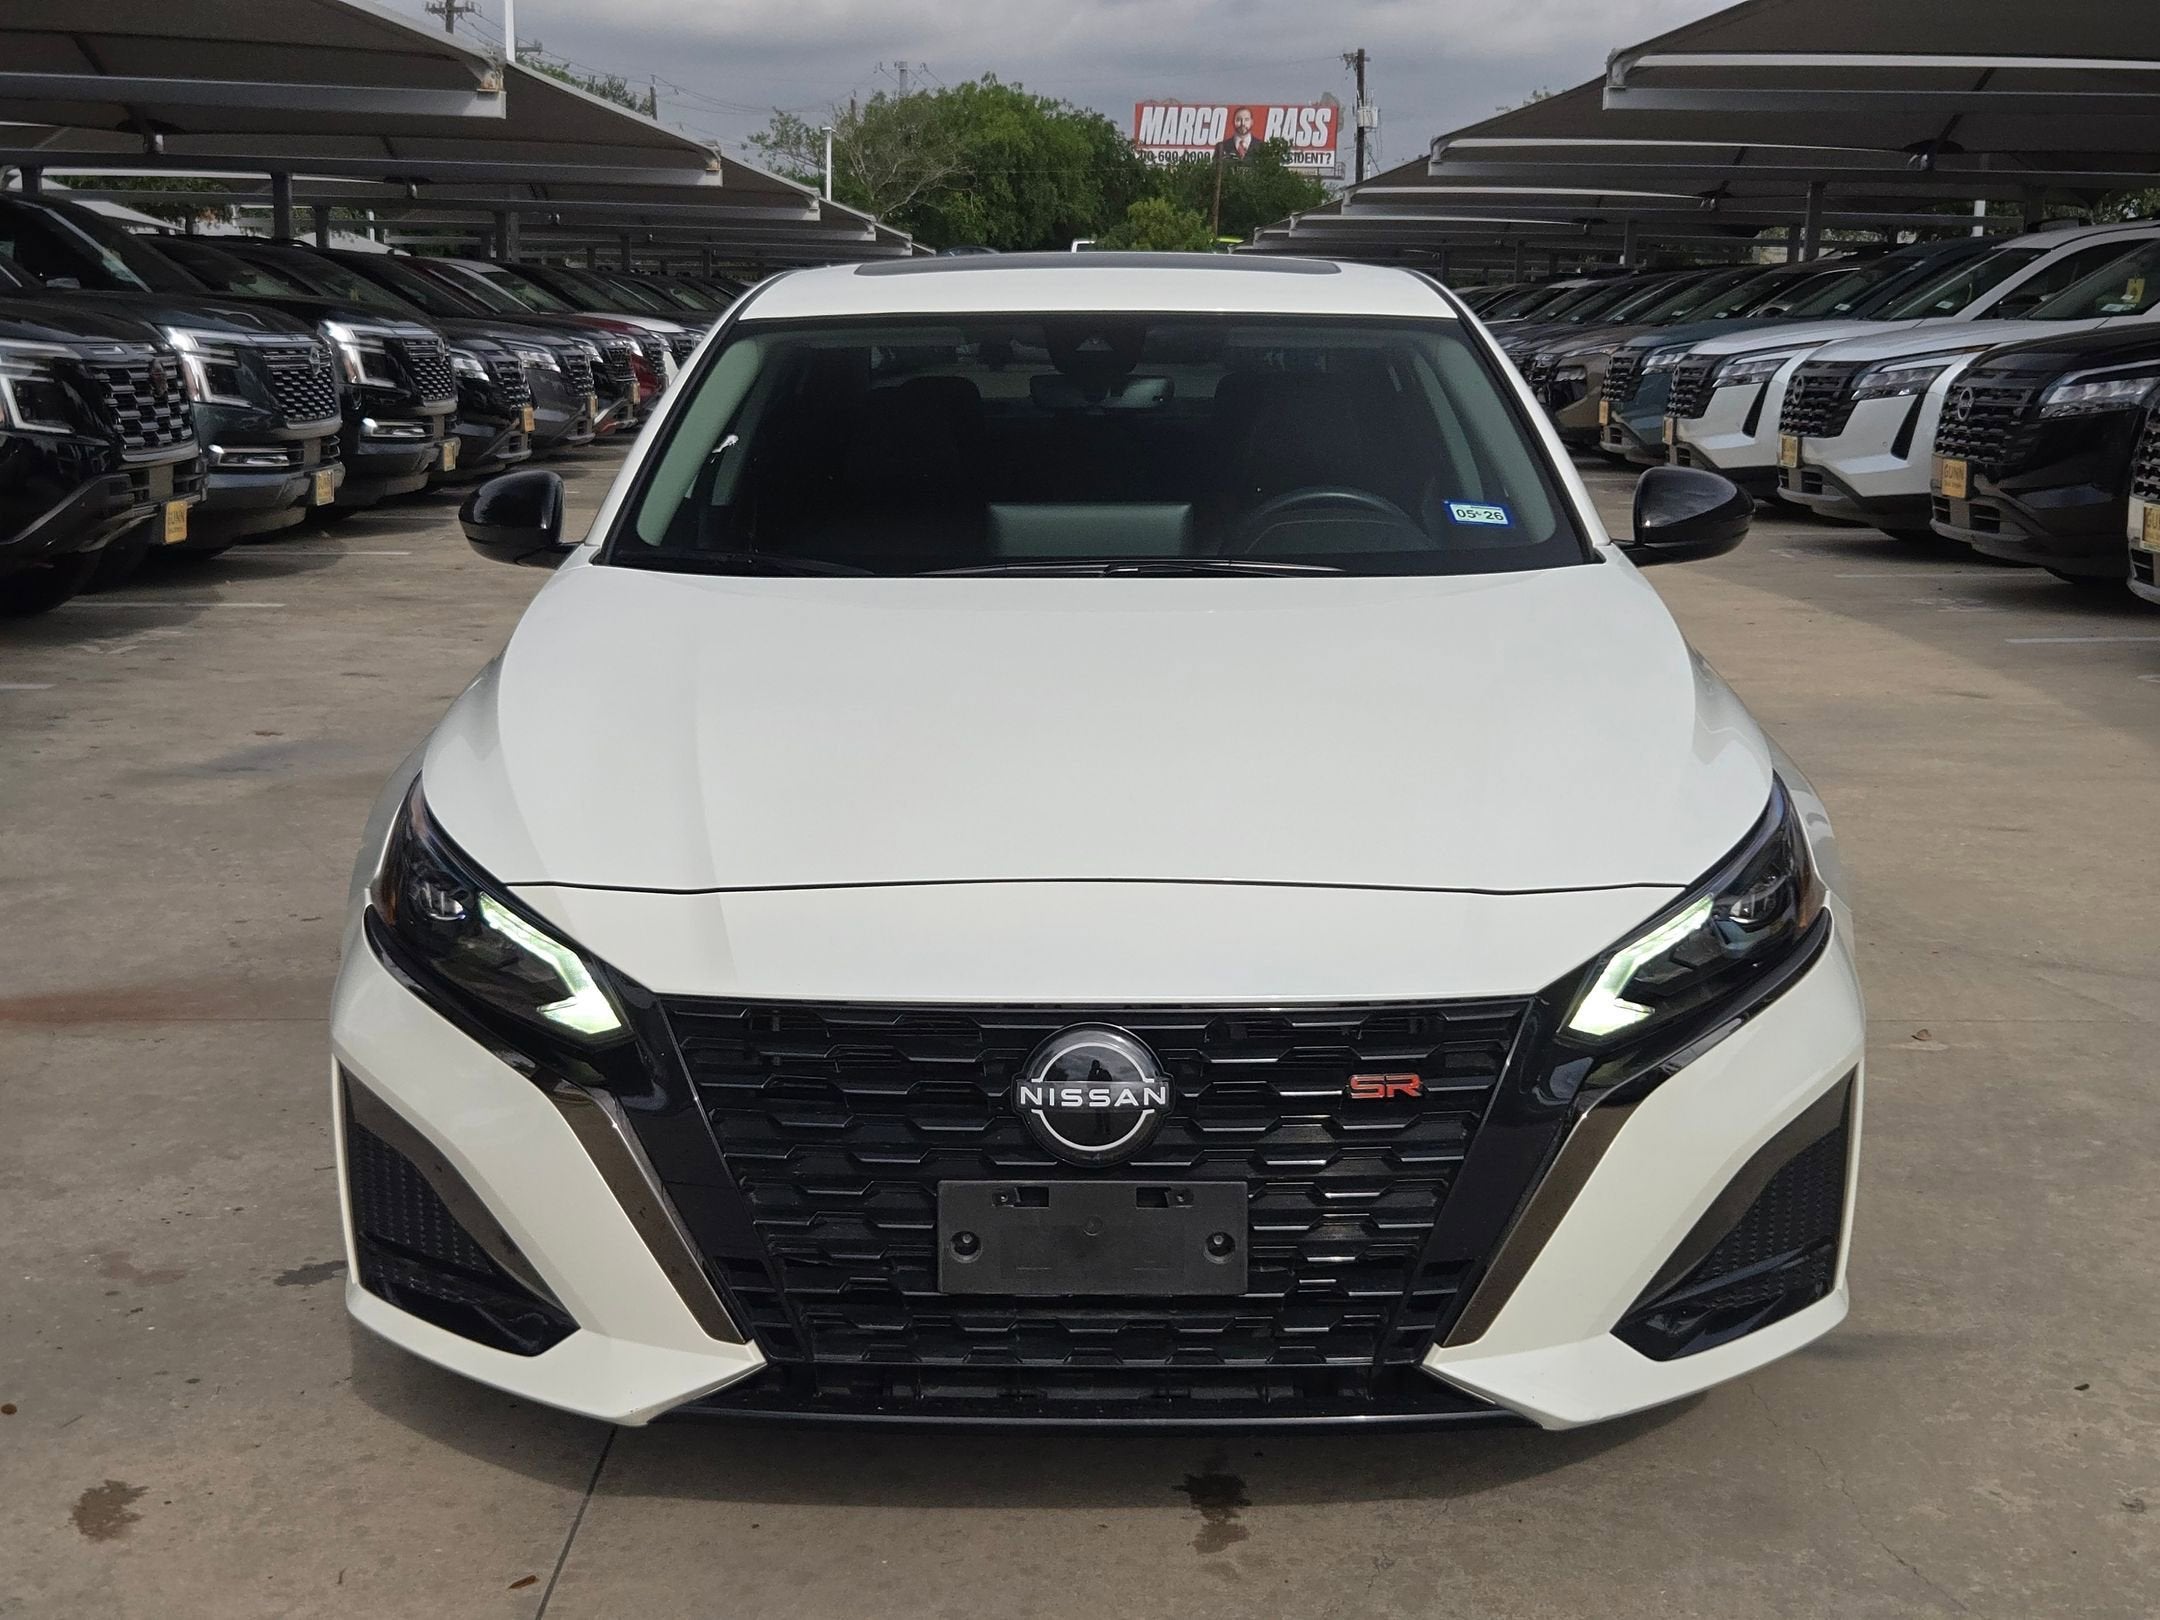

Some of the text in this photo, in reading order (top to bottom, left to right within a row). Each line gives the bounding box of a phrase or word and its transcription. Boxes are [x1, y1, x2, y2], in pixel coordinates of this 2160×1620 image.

[1139, 107, 1228, 145] MARCO
[1020, 1085, 1167, 1107] NISSAN
[1348, 1072, 1422, 1099] SR
